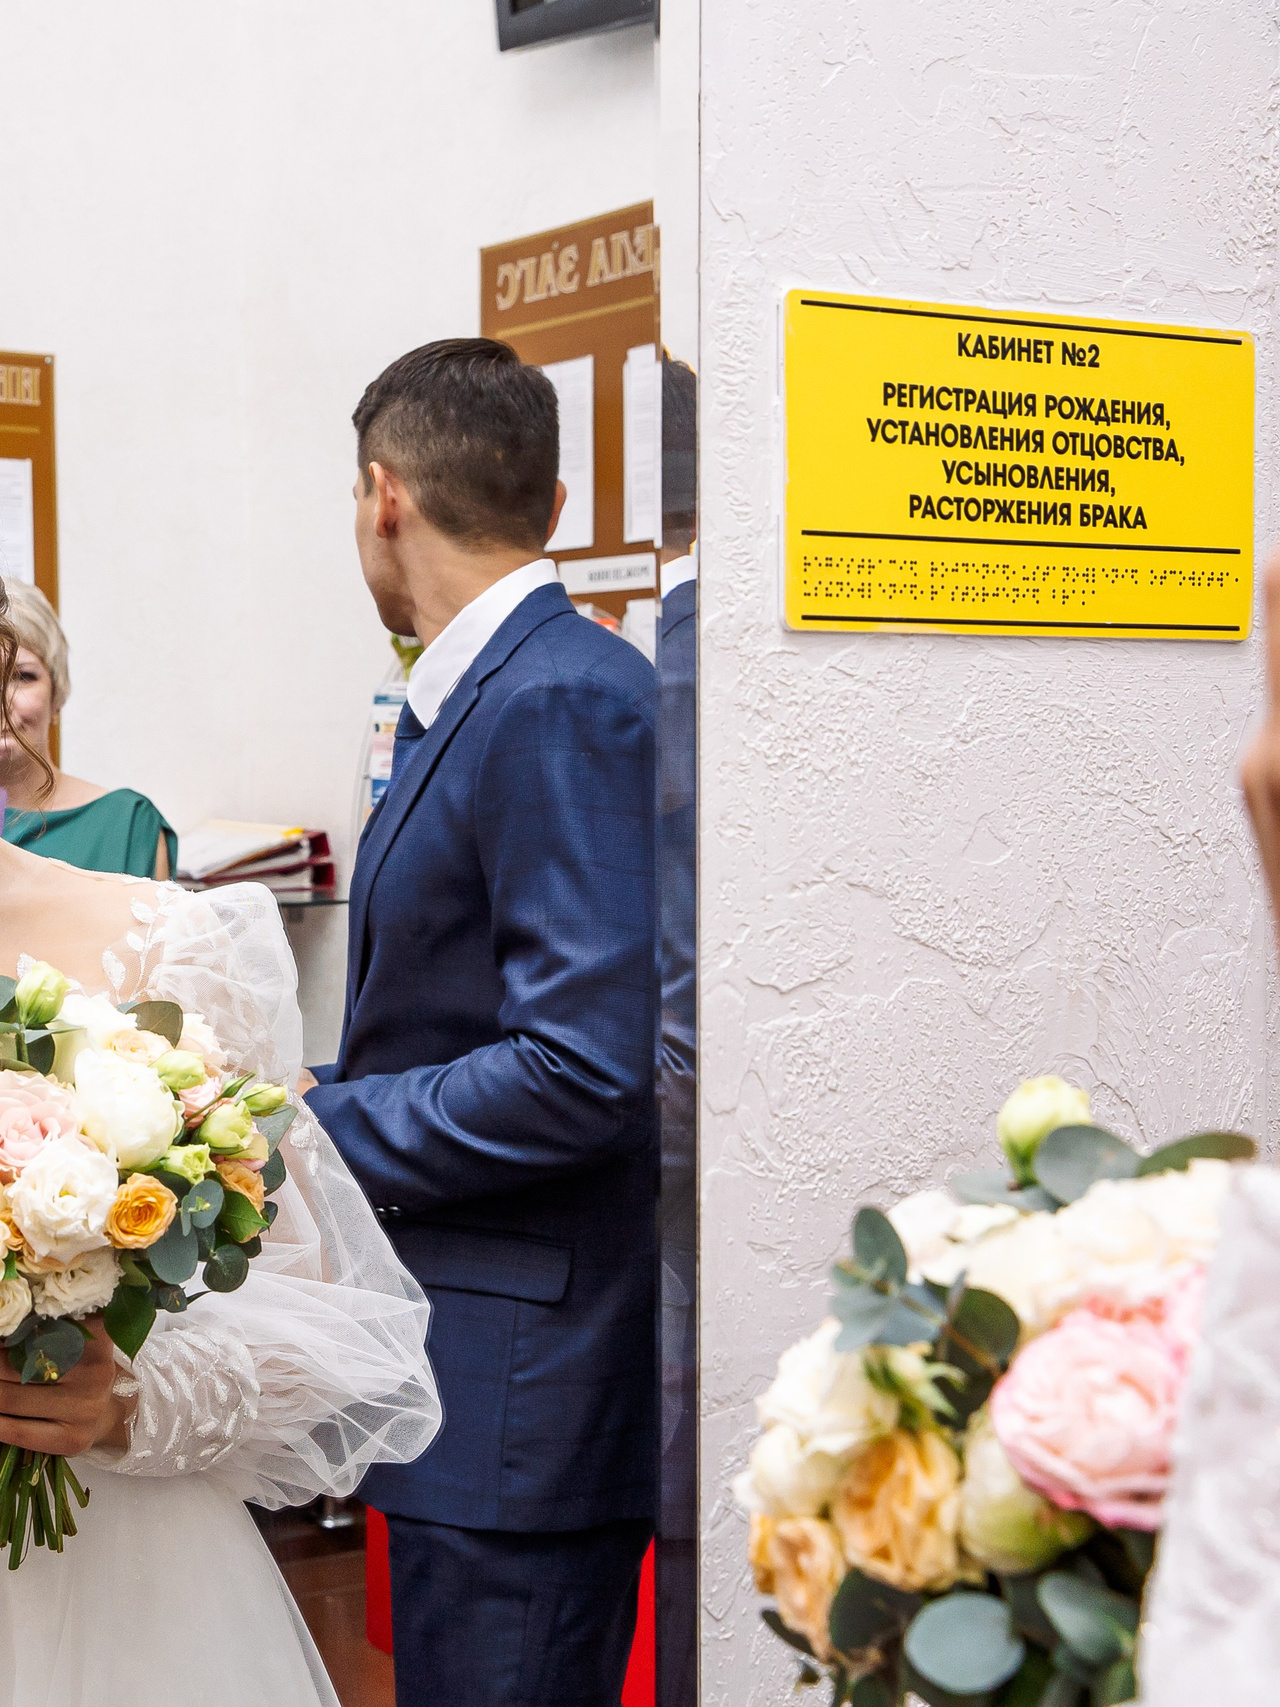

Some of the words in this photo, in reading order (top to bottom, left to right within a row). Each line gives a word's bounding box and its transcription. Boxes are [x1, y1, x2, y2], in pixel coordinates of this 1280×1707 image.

[957, 332, 1055, 365] КАБИНЕТ
[1061, 341, 1101, 369] №2
[883, 382, 1037, 420] РЕГИСТРАЦИЯ
[1044, 394, 1171, 431] РОЖДЕНИЯ,
[866, 417, 1045, 455] УСТАНОВЛЕНИЯ
[1052, 430, 1186, 468] ОТЦОВСТВА,
[941, 459, 1117, 498] УСЫНОВЛЕНИЯ,
[908, 494, 1073, 528] РАСТОРЖЕНИЯ
[1079, 503, 1149, 531] БРАКА
